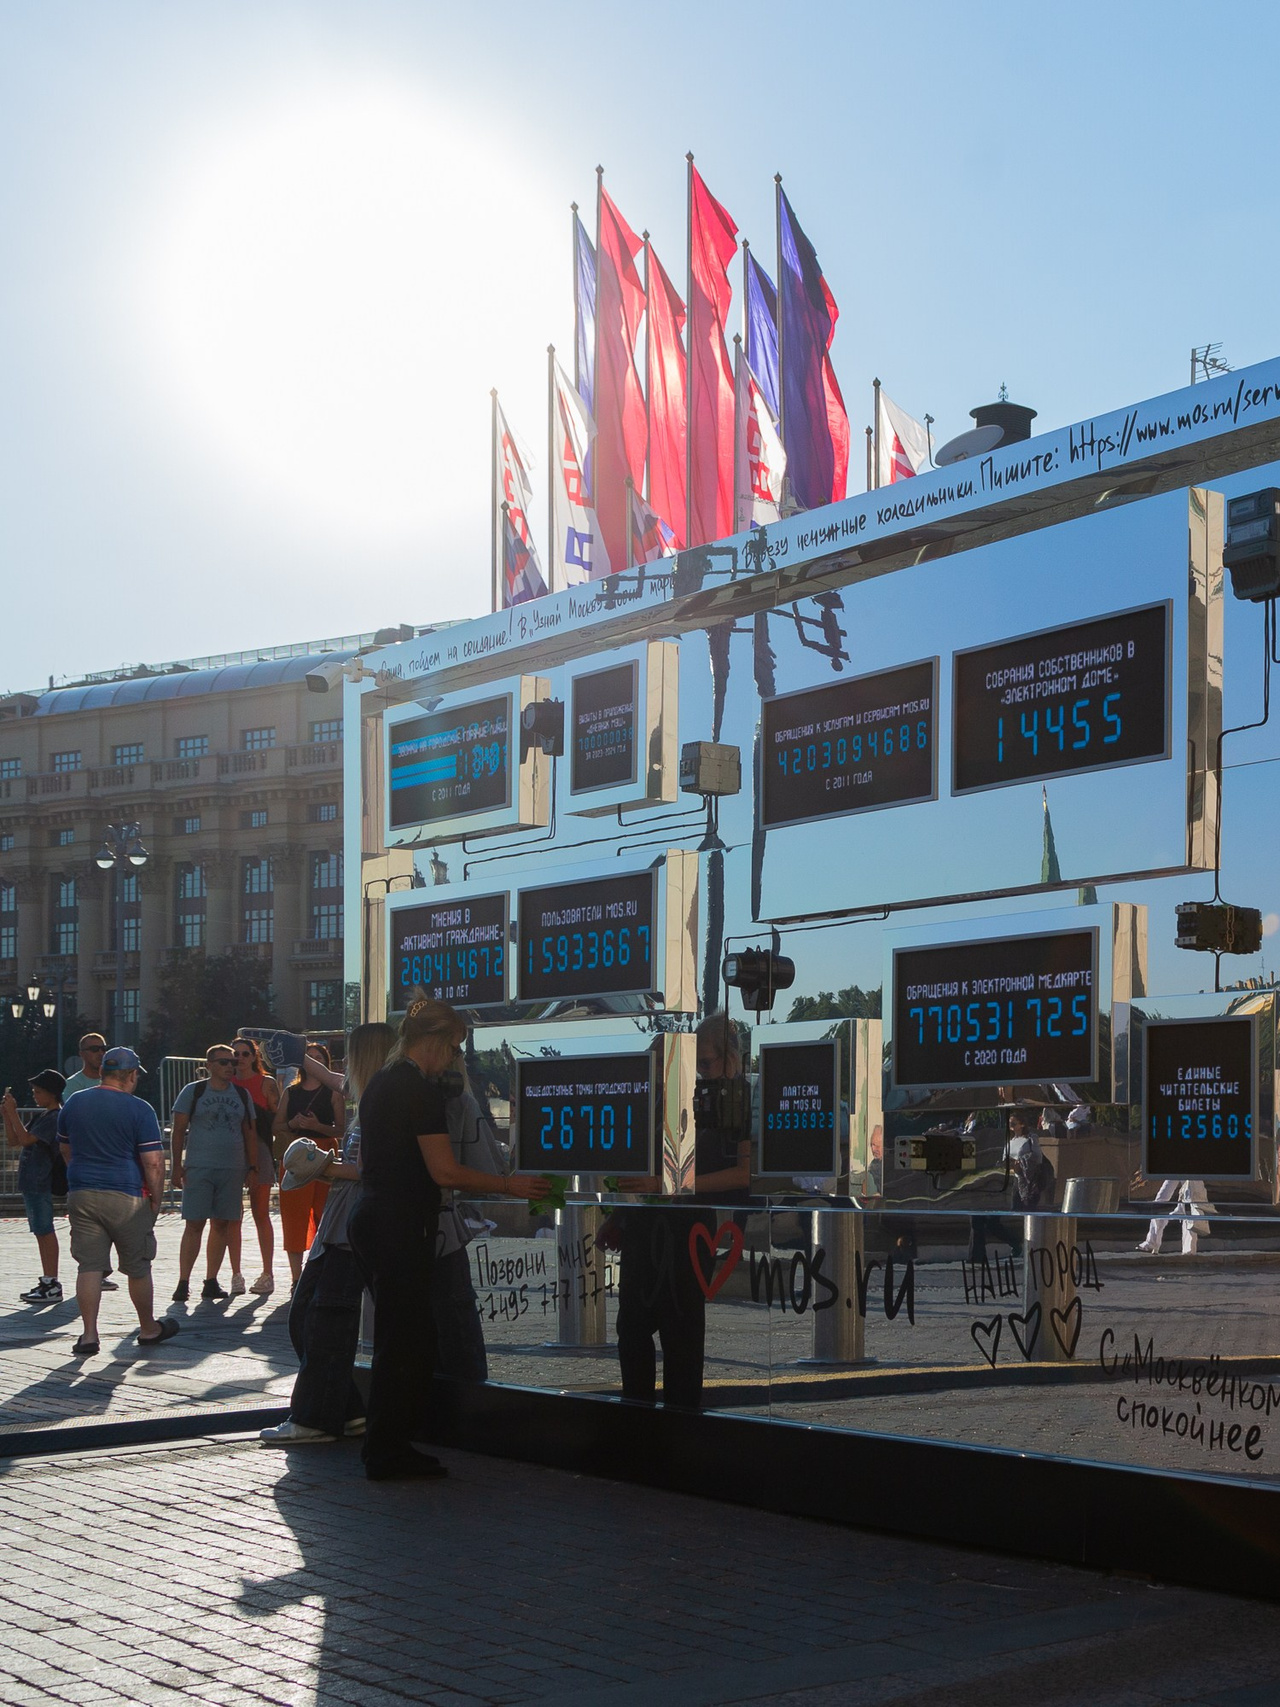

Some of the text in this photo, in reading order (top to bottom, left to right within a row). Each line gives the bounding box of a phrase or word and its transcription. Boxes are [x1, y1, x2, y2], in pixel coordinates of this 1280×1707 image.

[980, 447, 1060, 492] Пишите:
[447, 646, 459, 662] на
[463, 608, 513, 657] свидание!
[517, 613, 528, 640] В
[985, 640, 1135, 690] СОБРАНИЯ СОБСТВЕННИКОВ В
[1000, 667, 1119, 705] «ЭЛЕКТРОННОМ ДОМЕ»
[775, 698, 930, 743] ОБРАЩЕНИЯ К УСЛУГАМ И СЕРВИСАМ MOS.RU
[998, 692, 1122, 763] 14455
[778, 721, 927, 776] 4203094686
[432, 782, 471, 802] С 2011 ГОДА
[825, 770, 873, 790] С 2011 ГОДА
[431, 908, 471, 928] МНЕНИЯ В
[541, 900, 638, 927] ПОЛЬЗОВАТЕЛИ MOS.RU
[400, 924, 504, 951] «АКТИВНОМ ГРАЖДАНИНЕ»
[528, 925, 650, 975] 15933667
[401, 945, 504, 986] 260414672
[434, 984, 469, 999] ЗА 10 ЛЕТ
[906, 970, 1092, 1001] ОБРАЩЕНИЯ К ЭЛЕКТРОННОЙ МЕДКАРТЕ
[909, 995, 1087, 1045] 770531725
[964, 1048, 1027, 1066] С 2020 ГОДА
[1160, 1081, 1240, 1096] ЧИТАТЕЛЬСКИЕ
[1177, 1066, 1221, 1081] ЕДИНЫЕ
[525, 1084, 574, 1097] ОБЩЕДОСТУПНЫЕ
[575, 1083, 593, 1095] ТОЧКИ
[594, 1082, 631, 1095] ГОРОДСКОГО
[779, 1098, 822, 1111] НА MOS.RU
[782, 1085, 819, 1096] ПЛАТЕЖИ
[1178, 1098, 1221, 1112] БИЛЕТЫ
[541, 1105, 632, 1150] 26701
[476, 1243, 547, 1288] Позвони
[1117, 1396, 1264, 1461] спокойнее
